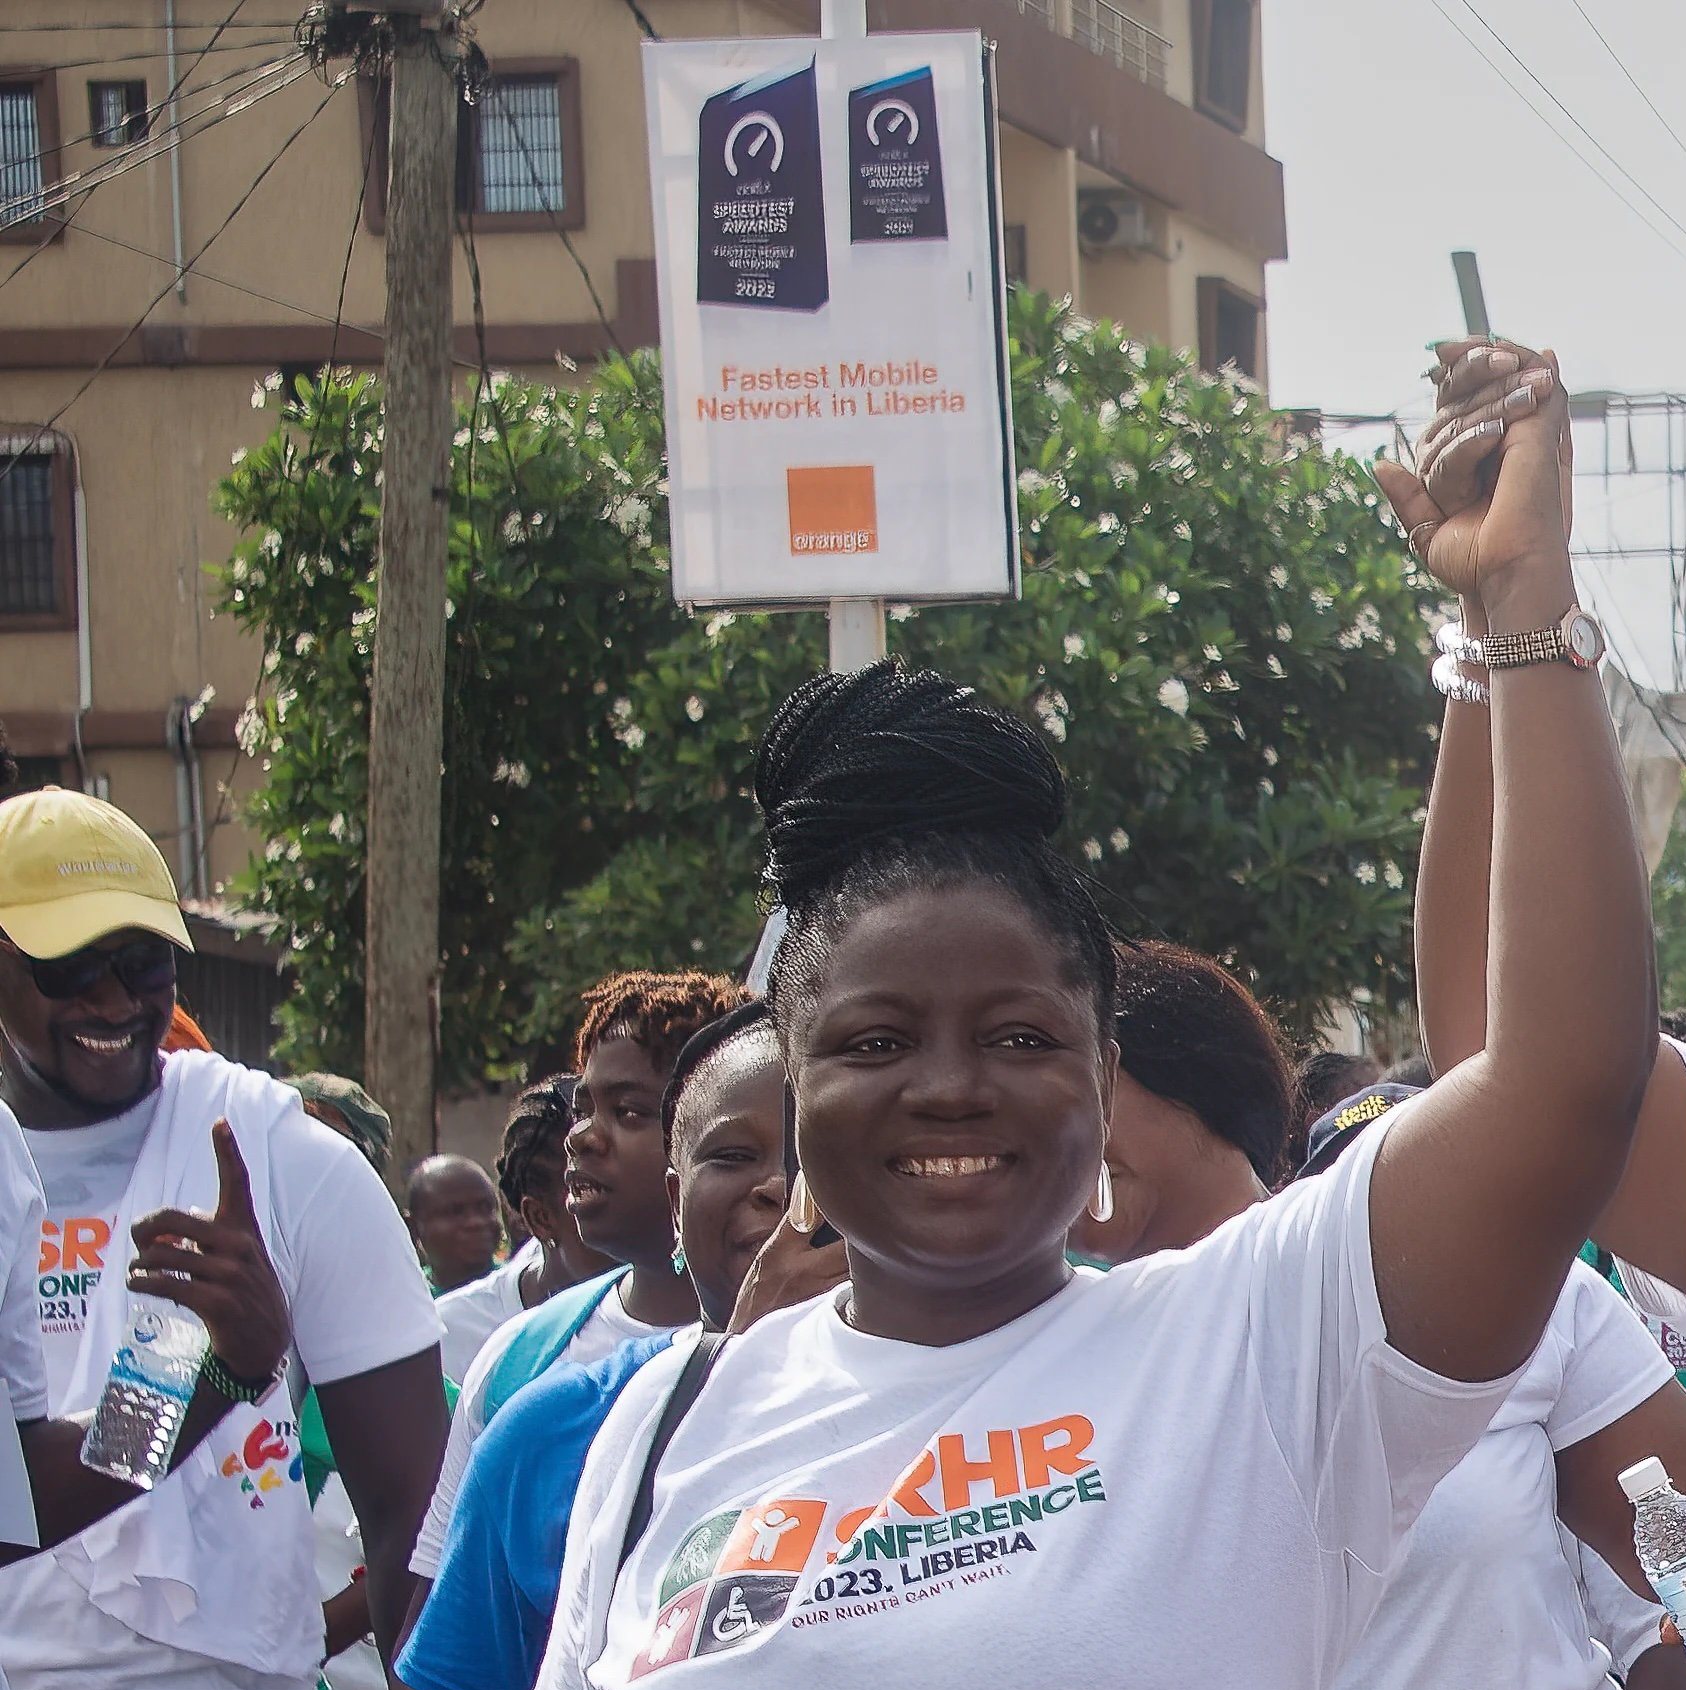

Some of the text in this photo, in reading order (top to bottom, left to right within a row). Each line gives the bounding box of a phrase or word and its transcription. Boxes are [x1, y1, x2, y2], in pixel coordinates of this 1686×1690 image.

[720, 359, 939, 391] Fastest Mobile
[696, 387, 966, 421] Network in Liberia
[792, 529, 870, 551] orange
[900, 1530, 1038, 1587] LIBERIA
[791, 1609, 830, 1629] OUR
[904, 1581, 956, 1605] CAN'T
